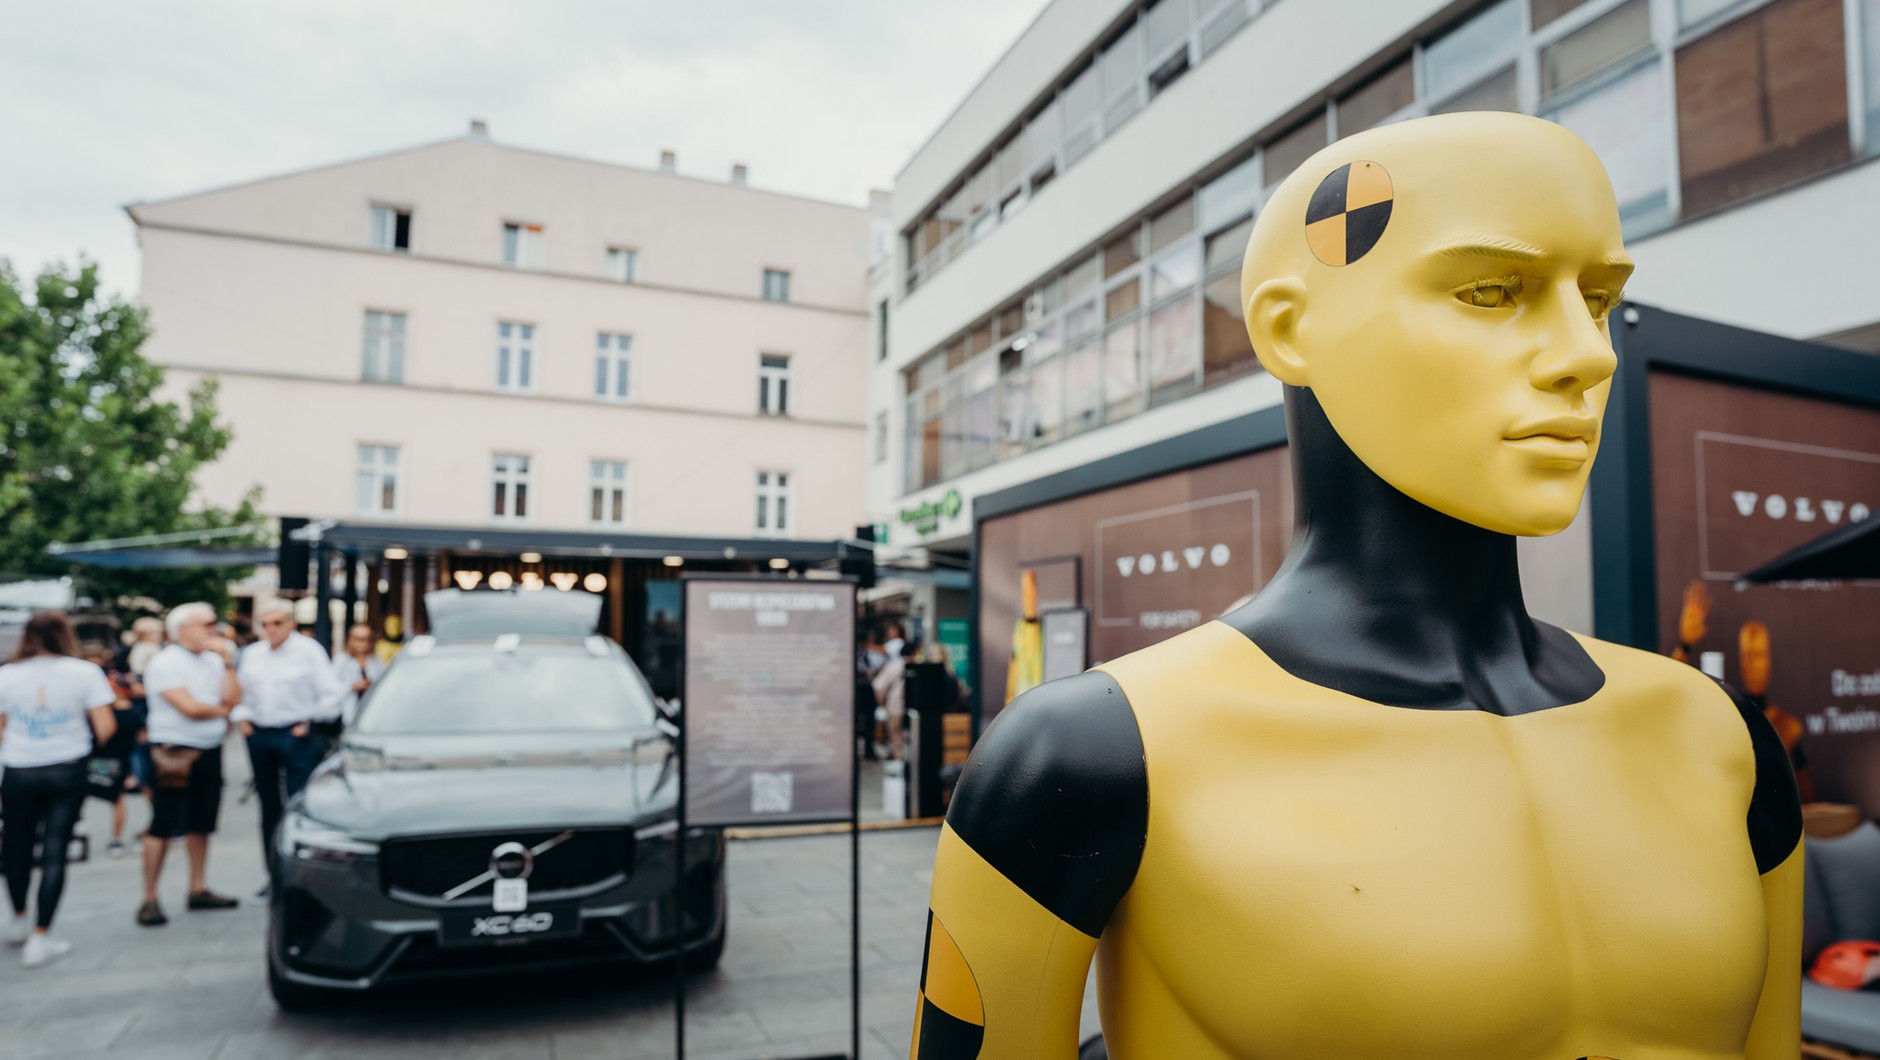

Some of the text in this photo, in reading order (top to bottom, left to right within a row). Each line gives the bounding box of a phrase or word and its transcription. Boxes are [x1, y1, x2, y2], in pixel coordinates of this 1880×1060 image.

[1732, 491, 1870, 524] VOLVO
[1116, 543, 1230, 577] VOLVO
[454, 570, 607, 592] VOLVO
[471, 912, 553, 937] XC60
